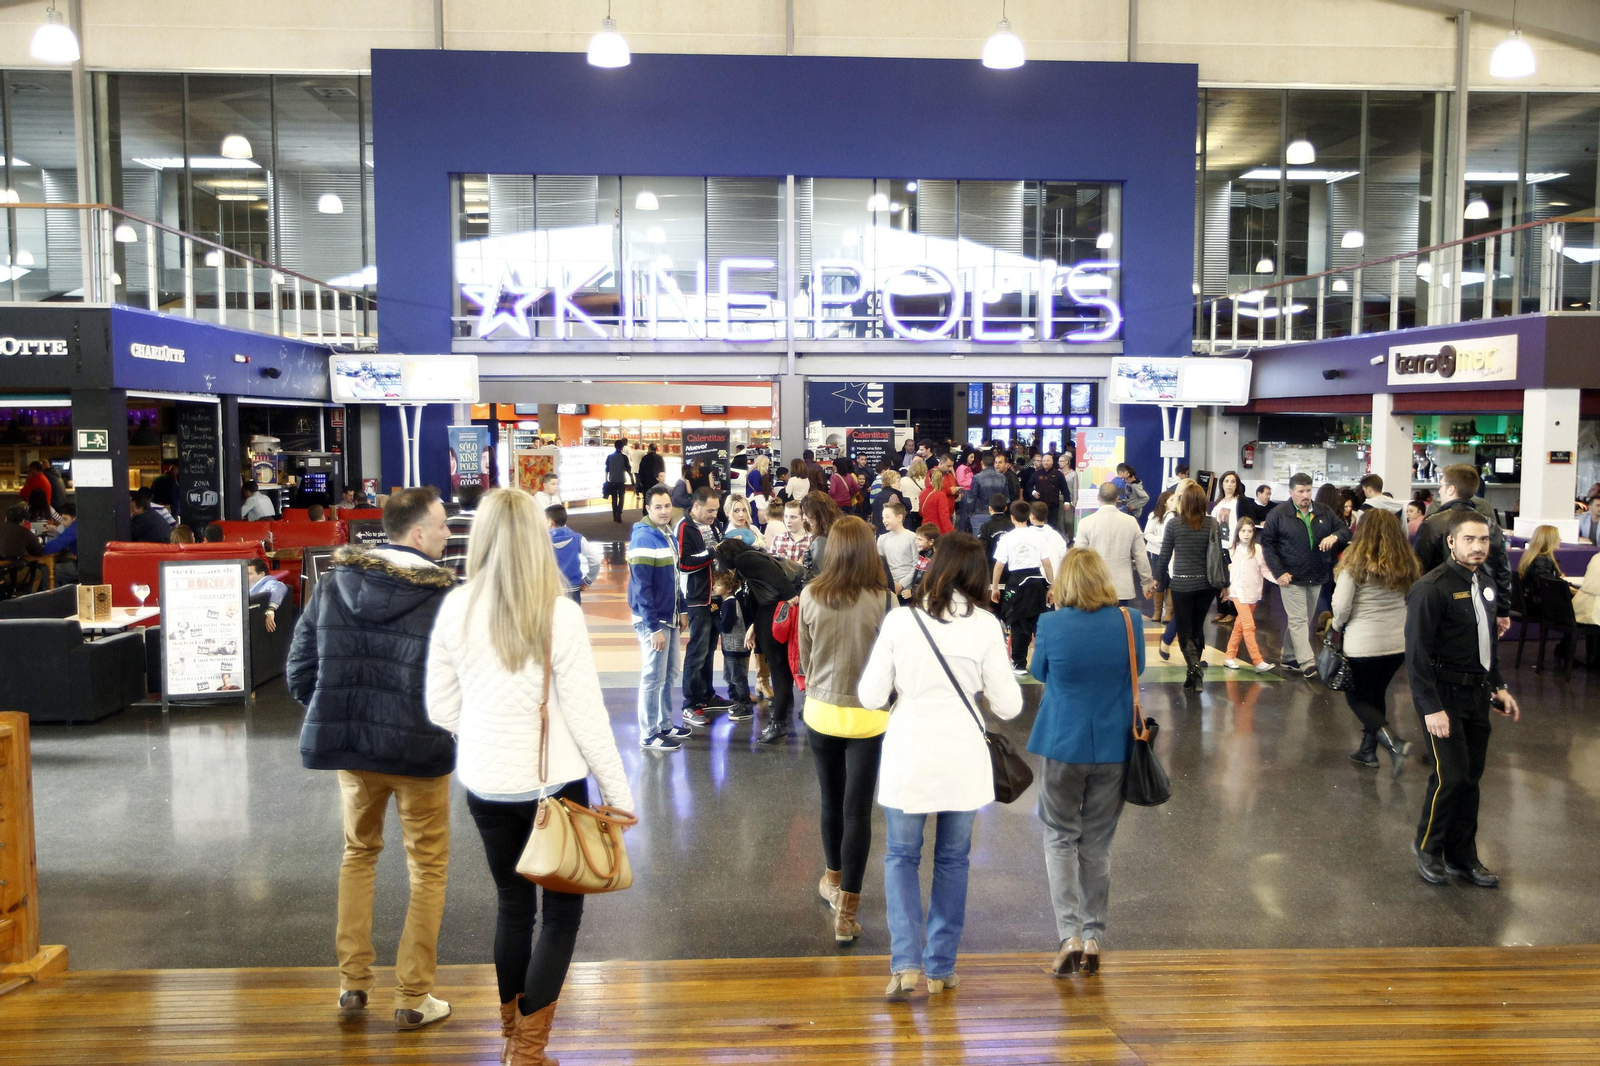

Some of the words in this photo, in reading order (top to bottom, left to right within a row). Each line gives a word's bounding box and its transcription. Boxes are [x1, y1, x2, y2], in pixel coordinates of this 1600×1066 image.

[130, 342, 186, 363] CHARLOTTE
[687, 434, 726, 442] Calentitas
[459, 462, 479, 471] POLIS
